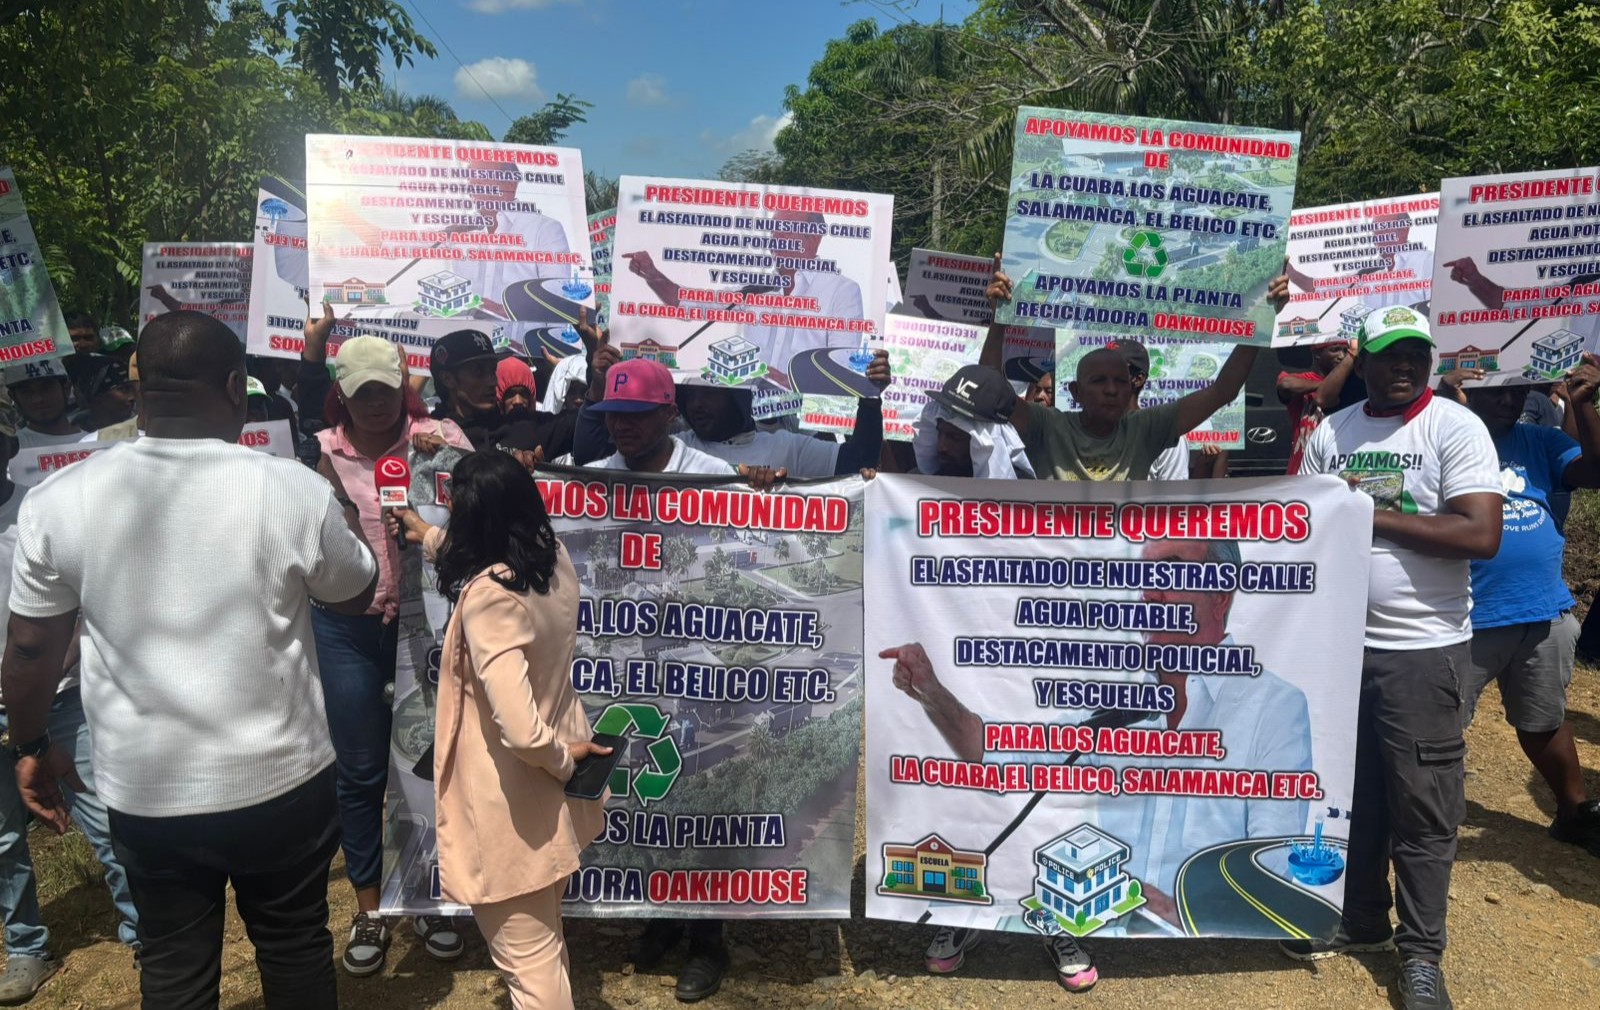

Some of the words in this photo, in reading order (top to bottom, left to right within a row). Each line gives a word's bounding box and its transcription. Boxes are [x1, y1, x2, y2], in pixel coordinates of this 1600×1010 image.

[1025, 117, 1136, 143] APOYAMOS
[1140, 129, 1164, 147] LA
[1168, 131, 1292, 159] COMUNIDAD
[455, 146, 559, 168] QUEREMOS
[1144, 151, 1170, 169] DE
[430, 167, 448, 179] DE
[450, 168, 522, 182] NUESTRAS
[525, 172, 565, 186] CALLE
[1468, 175, 1594, 204] PRESIDENTE
[644, 184, 760, 209] PRESIDENTE
[763, 192, 869, 217] QUEREMOS
[1030, 172, 1054, 189] LA
[1169, 186, 1273, 212] AGUACATE,
[639, 210, 655, 224] EL
[656, 211, 733, 229] ASFALTADO
[734, 216, 753, 230] DE
[755, 218, 828, 236] NUESTRAS
[830, 224, 872, 239] CALLE
[1016, 200, 1140, 227] SALAMANCA,
[1145, 212, 1165, 228] EL
[1169, 214, 1236, 235] BELICO
[1240, 221, 1280, 240] ETC.
[1290, 207, 1361, 226] RESIDENTE
[1364, 198, 1439, 217] QUEREMOS
[1462, 212, 1479, 228] EL
[1481, 206, 1563, 226] ASFALTADO
[1565, 204, 1585, 219] DE
[380, 230, 418, 243] PARA
[421, 230, 448, 243] LOS
[701, 233, 740, 247] AGUA
[743, 236, 806, 253] POTABLE,
[1528, 226, 1570, 242] AGUA
[160, 246, 232, 257] PRESIDENTE
[468, 249, 554, 265] SALAMANCA
[663, 248, 774, 268] DESTACAMENTO
[775, 256, 842, 275] POLICIAL,
[927, 255, 993, 274] PRESIDENT
[1299, 247, 1377, 264] DESTACAMENTO
[721, 271, 792, 287] ESCUELAS
[1536, 265, 1548, 280] Y
[678, 288, 715, 302] PARA
[718, 291, 743, 305] LOS
[745, 293, 821, 312] AGUACATE,
[1034, 275, 1141, 299] APOYAMOS
[1145, 283, 1168, 301] LA
[1172, 286, 1243, 308] PLANTA
[1502, 288, 1542, 303] PARA
[1544, 285, 1571, 301] LOS
[266, 314, 305, 331] CALLE
[619, 302, 636, 315] LA
[706, 309, 757, 325] BELICO,
[761, 313, 845, 332] SALAMANCA
[848, 319, 878, 335] ETC.
[1015, 301, 1149, 327] RECICLADORA
[1152, 315, 1256, 338] OAKHOUSE
[1438, 311, 1458, 326] LA
[1530, 303, 1584, 319] BELICO,
[0, 338, 57, 363] HOUSE
[1328, 452, 1423, 471] APOYAMOS!!
[612, 483, 653, 520] LA
[654, 486, 849, 533] COMUNIDAD
[917, 499, 1115, 538] PRESIDENTE
[1118, 501, 1310, 543] QUEREMOS
[1503, 524, 1520, 532] OVE
[621, 532, 662, 569] DE
[912, 557, 939, 585] EL
[939, 558, 1068, 588] ASFALTADO
[1072, 561, 1105, 588] DE
[1107, 561, 1237, 591] NUESTRAS
[1240, 564, 1315, 593] CALLE
[661, 602, 823, 649] AGUACATE,
[1016, 599, 1085, 629] AGUA
[1086, 601, 1198, 634] POTABLE,
[955, 638, 1142, 670] DESTACAMENTO
[1146, 645, 1262, 677] POLICIAL,
[626, 661, 660, 697] EL
[663, 663, 769, 701] BELICO
[773, 668, 836, 703] ETC.
[1034, 680, 1054, 707] Y
[1054, 681, 1176, 711] ESCUELAS
[984, 723, 1048, 753] PARA
[1049, 725, 1094, 755] LOS
[1096, 727, 1225, 759] AGUACATE,
[891, 758, 922, 784] LA
[1032, 766, 1120, 796] BELICO,
[1123, 769, 1269, 798] SALAMANCA
[1271, 773, 1324, 799] ETC.
[632, 811, 673, 847] LA
[673, 813, 786, 848] PLANTA
[920, 856, 949, 867] ESCUELA
[1048, 860, 1075, 880] POLICE
[1094, 854, 1121, 874] POLICE
[647, 868, 807, 904] OAKHOUSE
